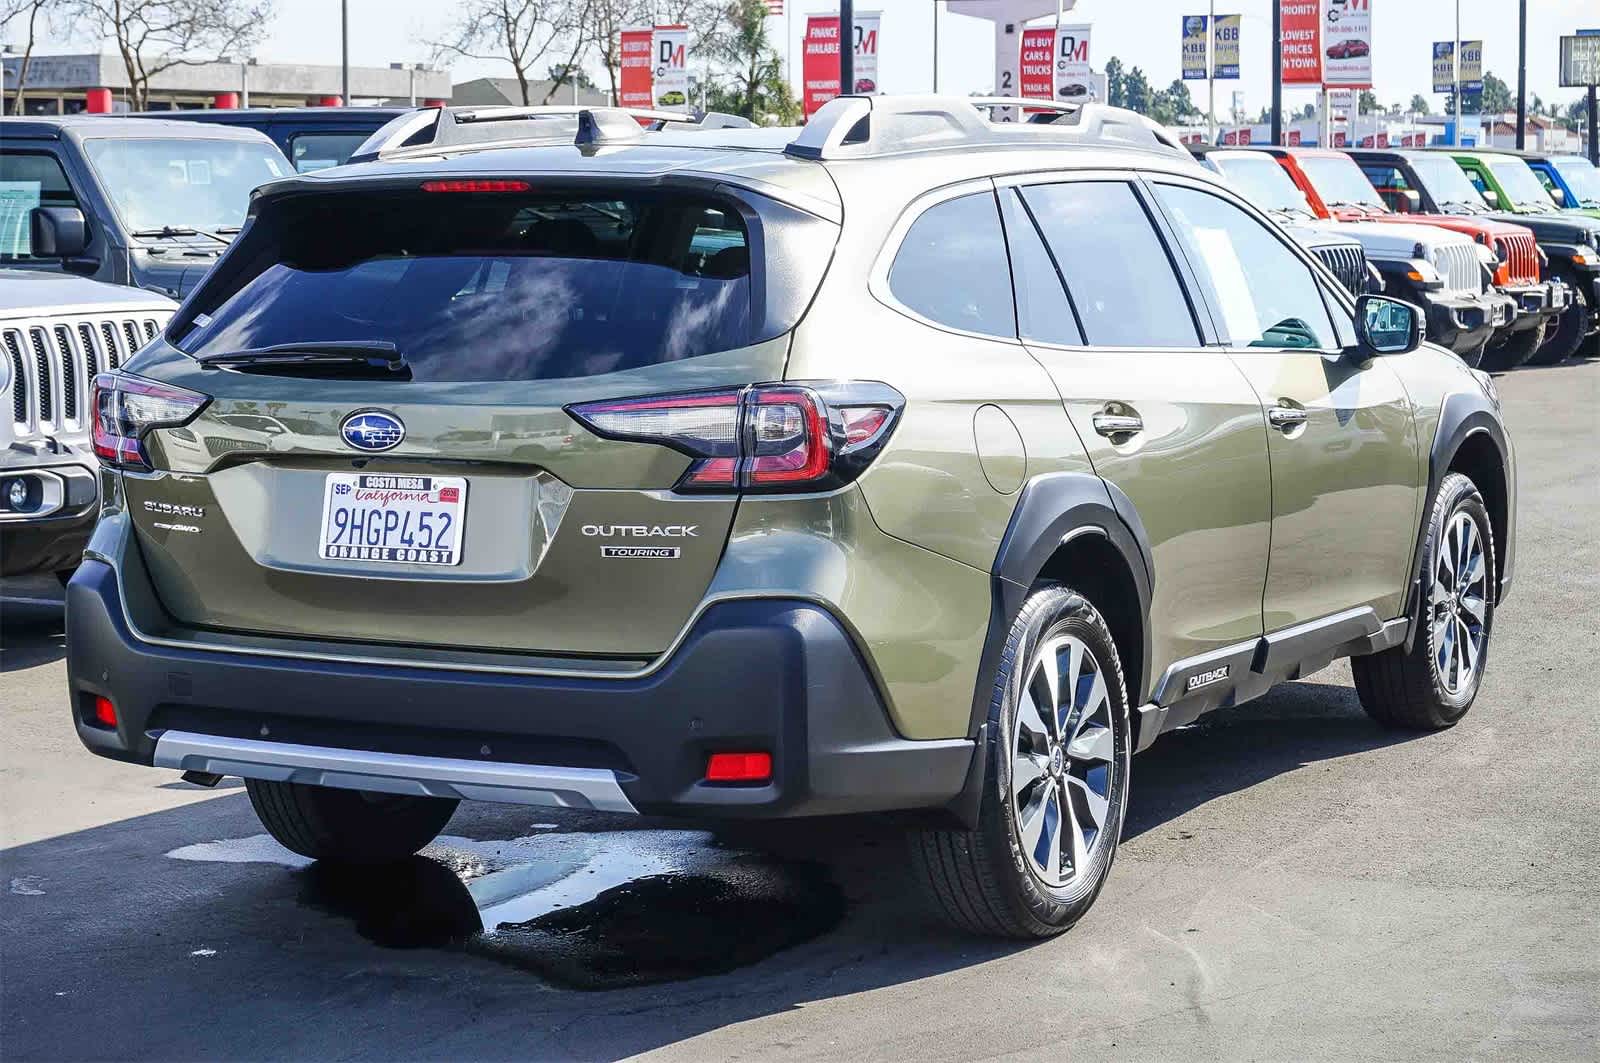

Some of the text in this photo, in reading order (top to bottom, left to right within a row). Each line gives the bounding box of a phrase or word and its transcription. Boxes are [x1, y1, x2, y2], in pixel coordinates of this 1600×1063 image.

[810, 27, 838, 38] FINANCE
[1215, 27, 1239, 41] KBB
[1281, 29, 1315, 40] LOWEST
[1024, 37, 1053, 48] WE BUY
[1183, 42, 1206, 53] KBB
[806, 43, 840, 55] AVAILABLE
[1283, 44, 1313, 54] PRICES
[1023, 50, 1051, 61] CARS &
[1291, 58, 1317, 68] TOWN
[1022, 65, 1052, 75] TRUCKS
[366, 476, 424, 490] COSTA MESA
[335, 484, 352, 495] SEP
[355, 488, 439, 507] California
[143, 500, 203, 517] SUBARU
[331, 507, 453, 550] 9HGP452
[581, 524, 699, 537] OUTBACK
[328, 545, 450, 564] ORANGE COAST
[609, 549, 670, 557] TOURING
[1189, 666, 1228, 687] OUTBACK
